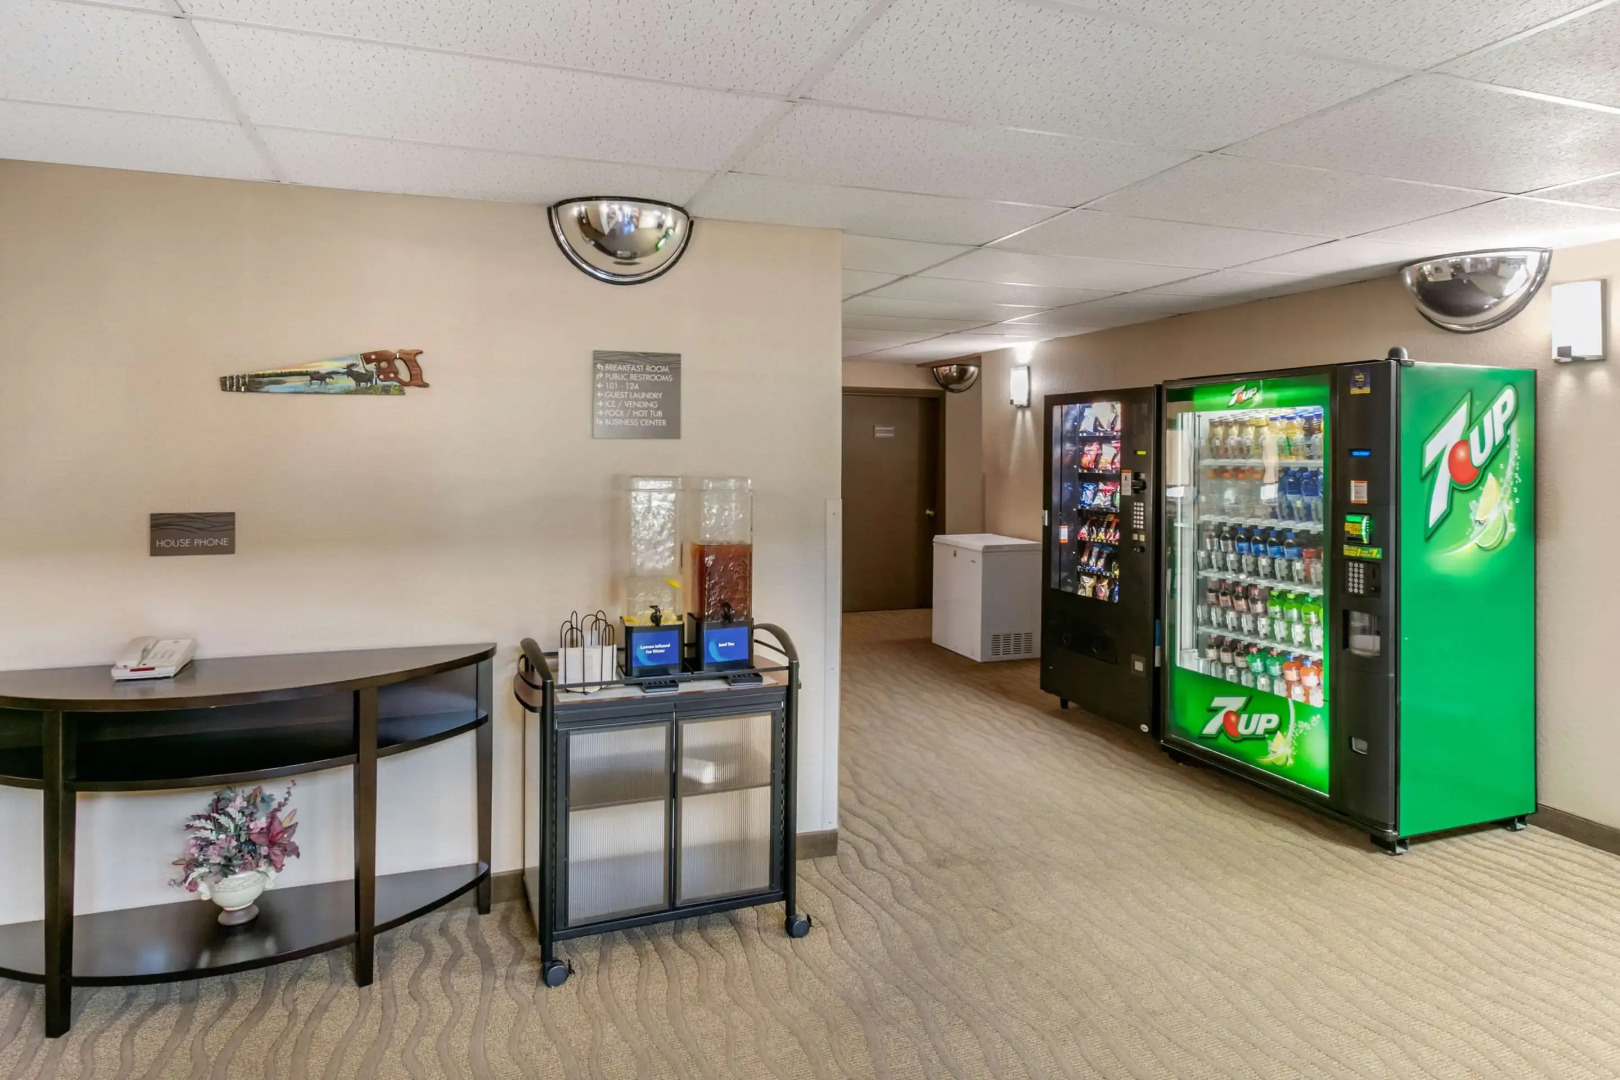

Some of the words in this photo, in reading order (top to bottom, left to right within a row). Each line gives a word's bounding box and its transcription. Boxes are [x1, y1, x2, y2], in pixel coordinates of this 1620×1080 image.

[604, 364, 644, 372] BREAKFAST
[646, 365, 669, 373] ROOM
[630, 374, 673, 382] RESTROOMS
[625, 382, 639, 390] 124
[629, 392, 663, 400] LAUNDRY
[1228, 384, 1258, 405] 7UP
[624, 401, 658, 409] VENDING
[604, 409, 624, 417] POOL
[650, 410, 663, 418] TUB
[604, 418, 638, 426] BUSINESS
[640, 419, 667, 427] CENTER
[1424, 388, 1515, 529] 7UP
[156, 538, 191, 548] HOUSE
[194, 537, 229, 547] PHONE
[1201, 696, 1280, 736] 7UP
